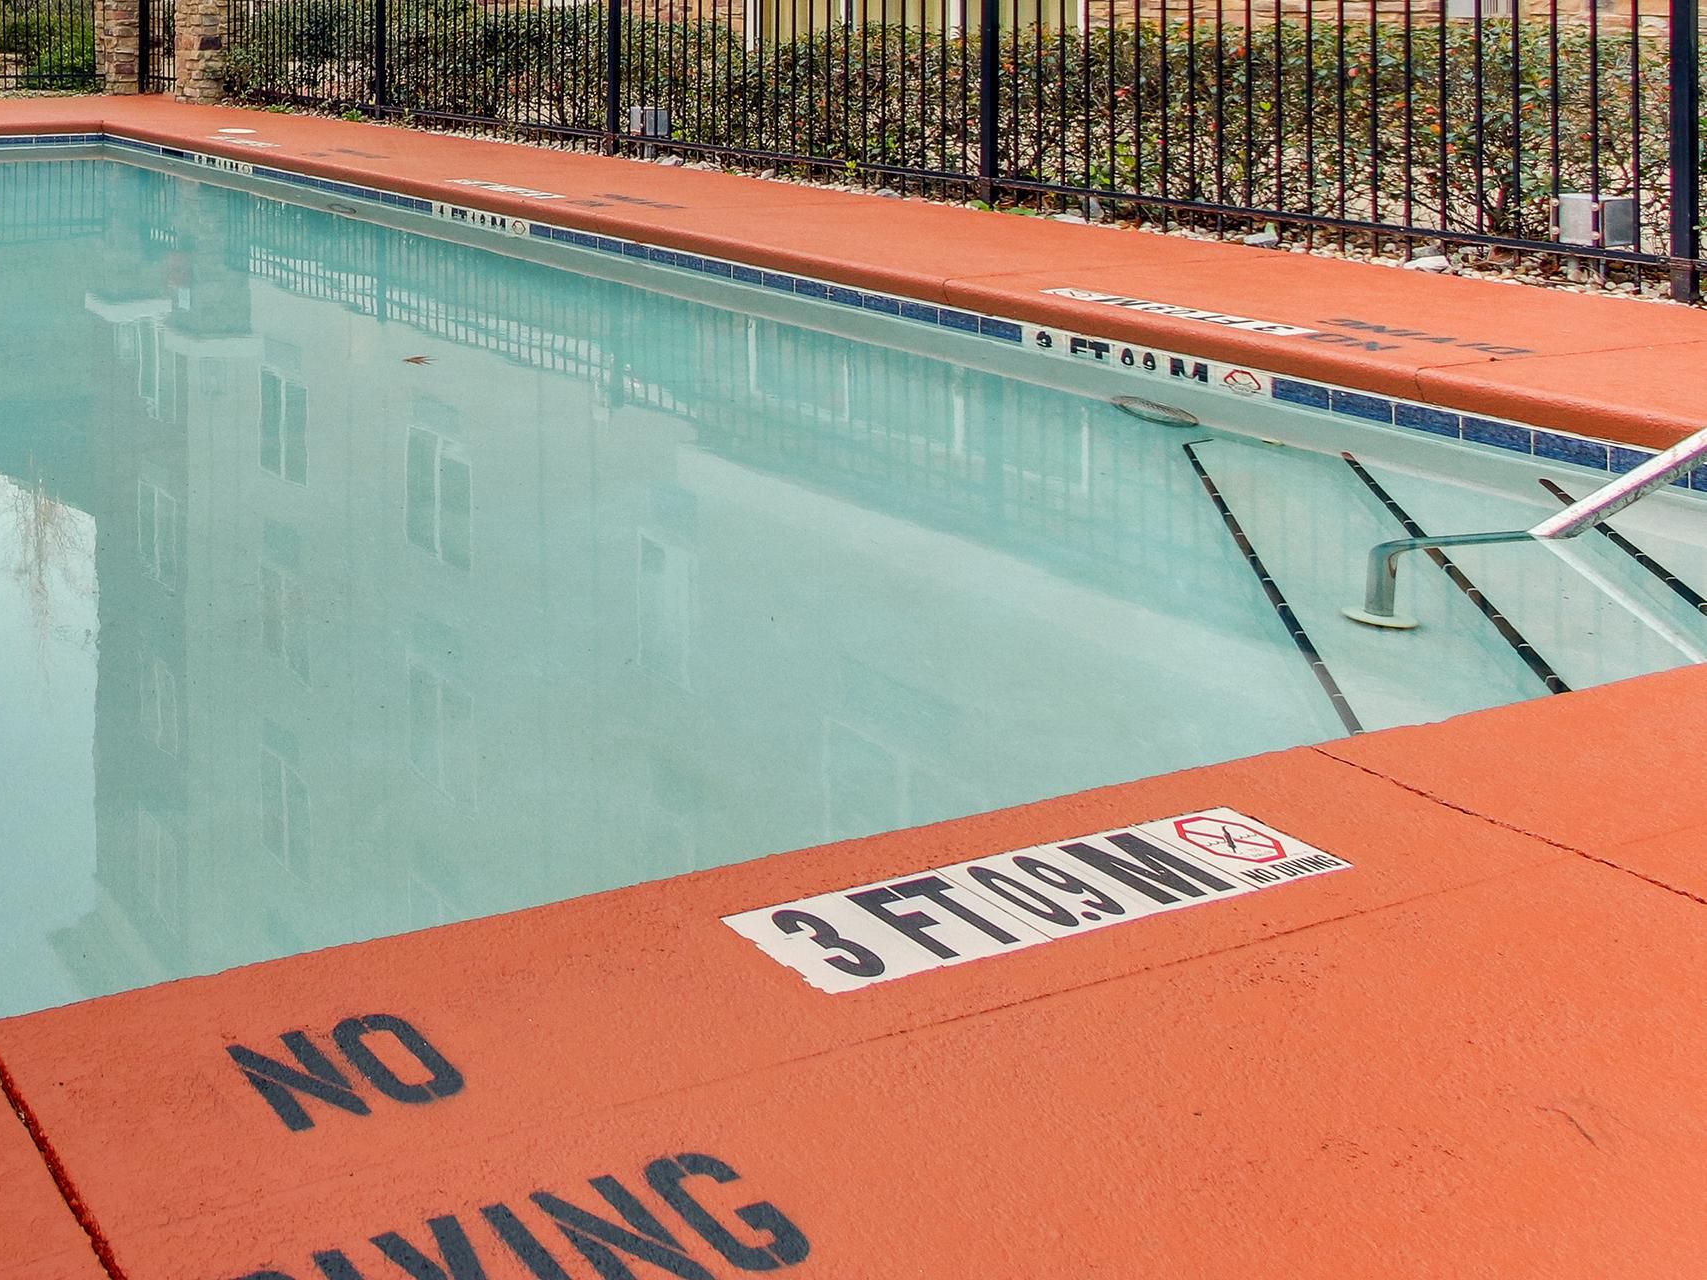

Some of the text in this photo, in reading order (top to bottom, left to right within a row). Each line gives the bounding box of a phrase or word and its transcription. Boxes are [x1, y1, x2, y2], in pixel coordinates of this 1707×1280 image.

[1070, 336, 1110, 363] FT
[771, 831, 1238, 979] 3 FT 0.9 M
[1239, 854, 1347, 884] NO DIVING
[225, 1013, 465, 1132] NO
